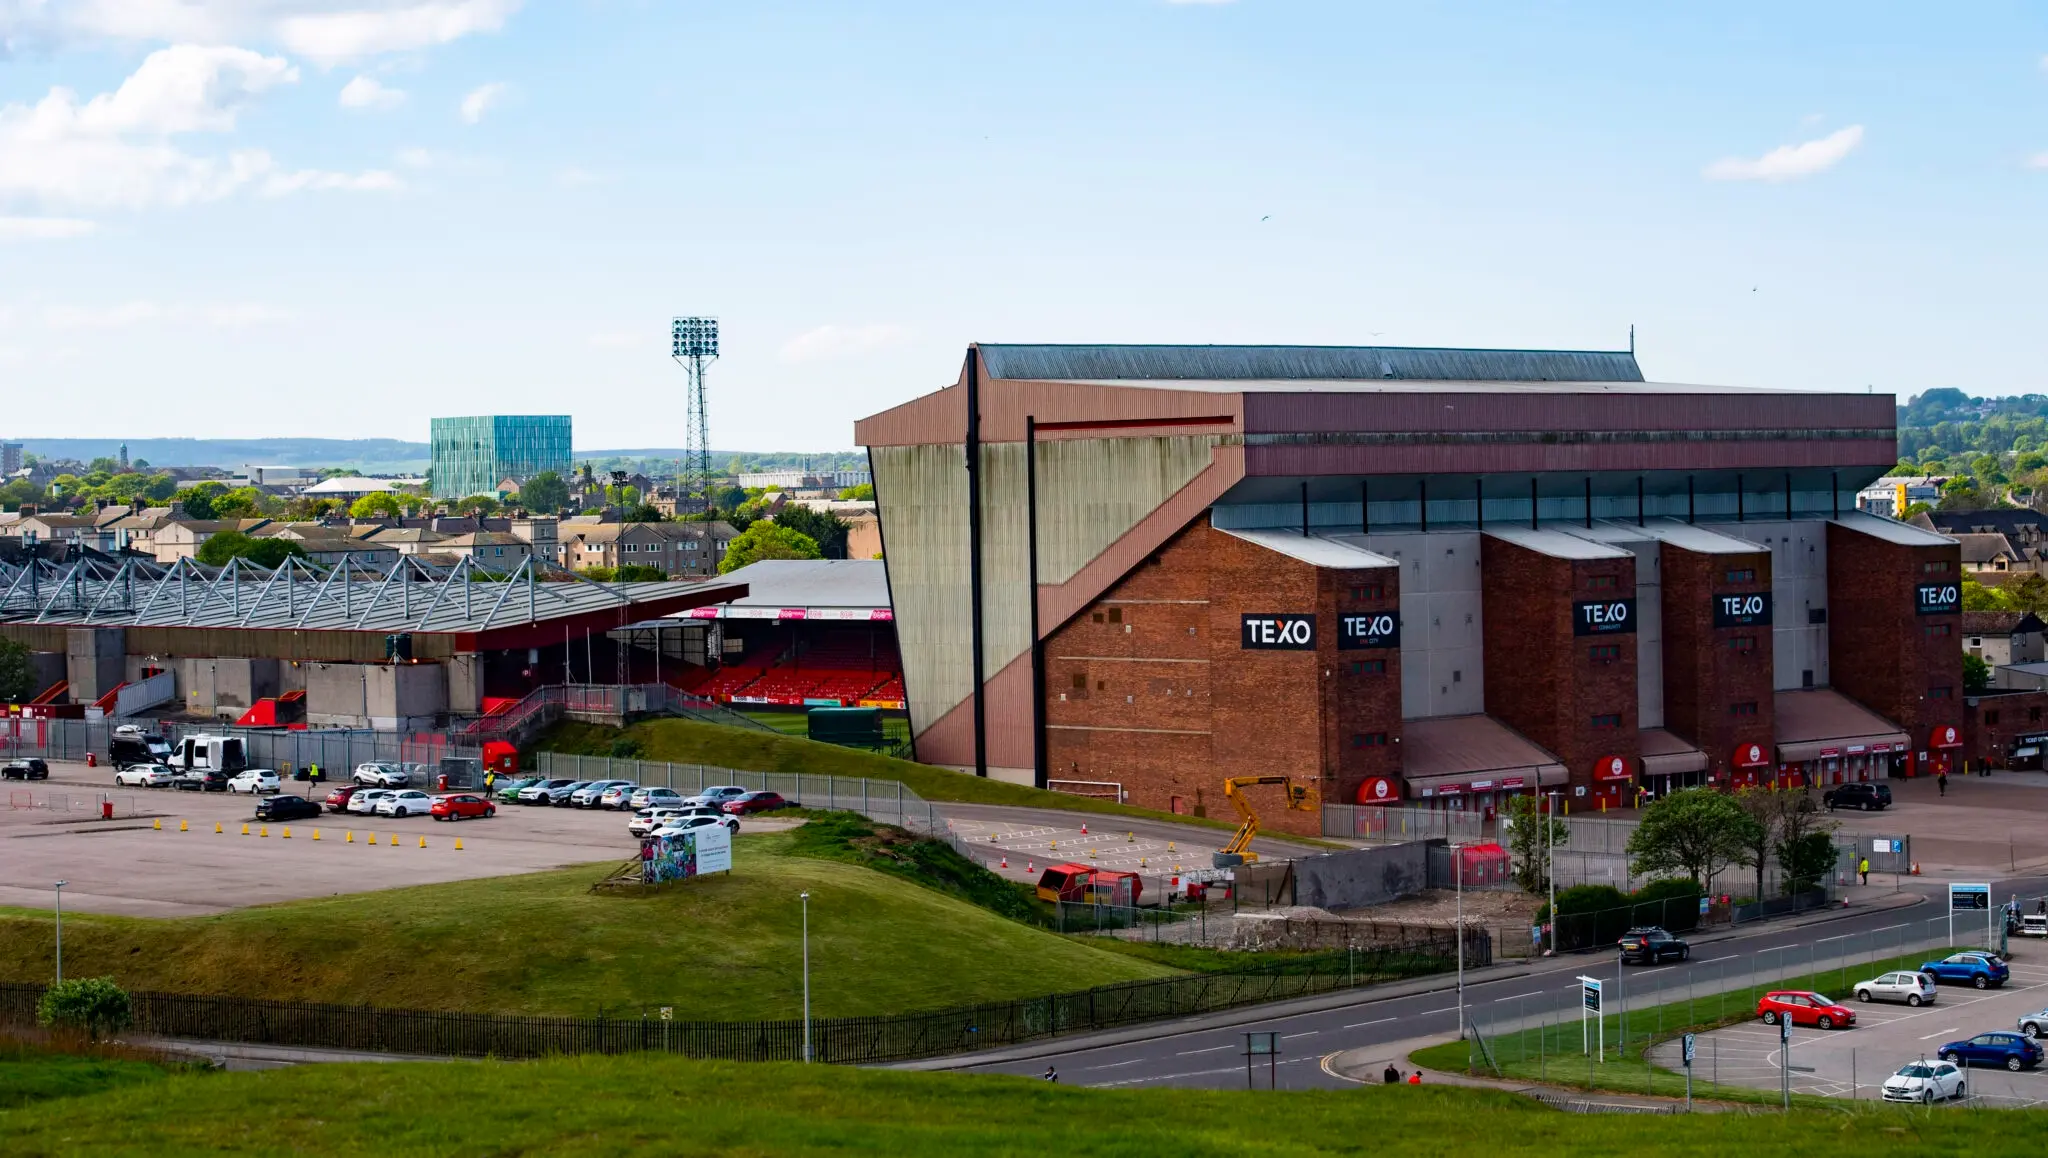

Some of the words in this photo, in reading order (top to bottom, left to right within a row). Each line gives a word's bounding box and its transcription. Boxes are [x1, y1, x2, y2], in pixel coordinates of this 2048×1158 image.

[1919, 586, 1957, 604] TEXO
[1583, 603, 1627, 623] TEXO
[1722, 596, 1763, 615] TEXO
[1246, 619, 1311, 644] TEXO
[1344, 615, 1393, 636] TEXO
